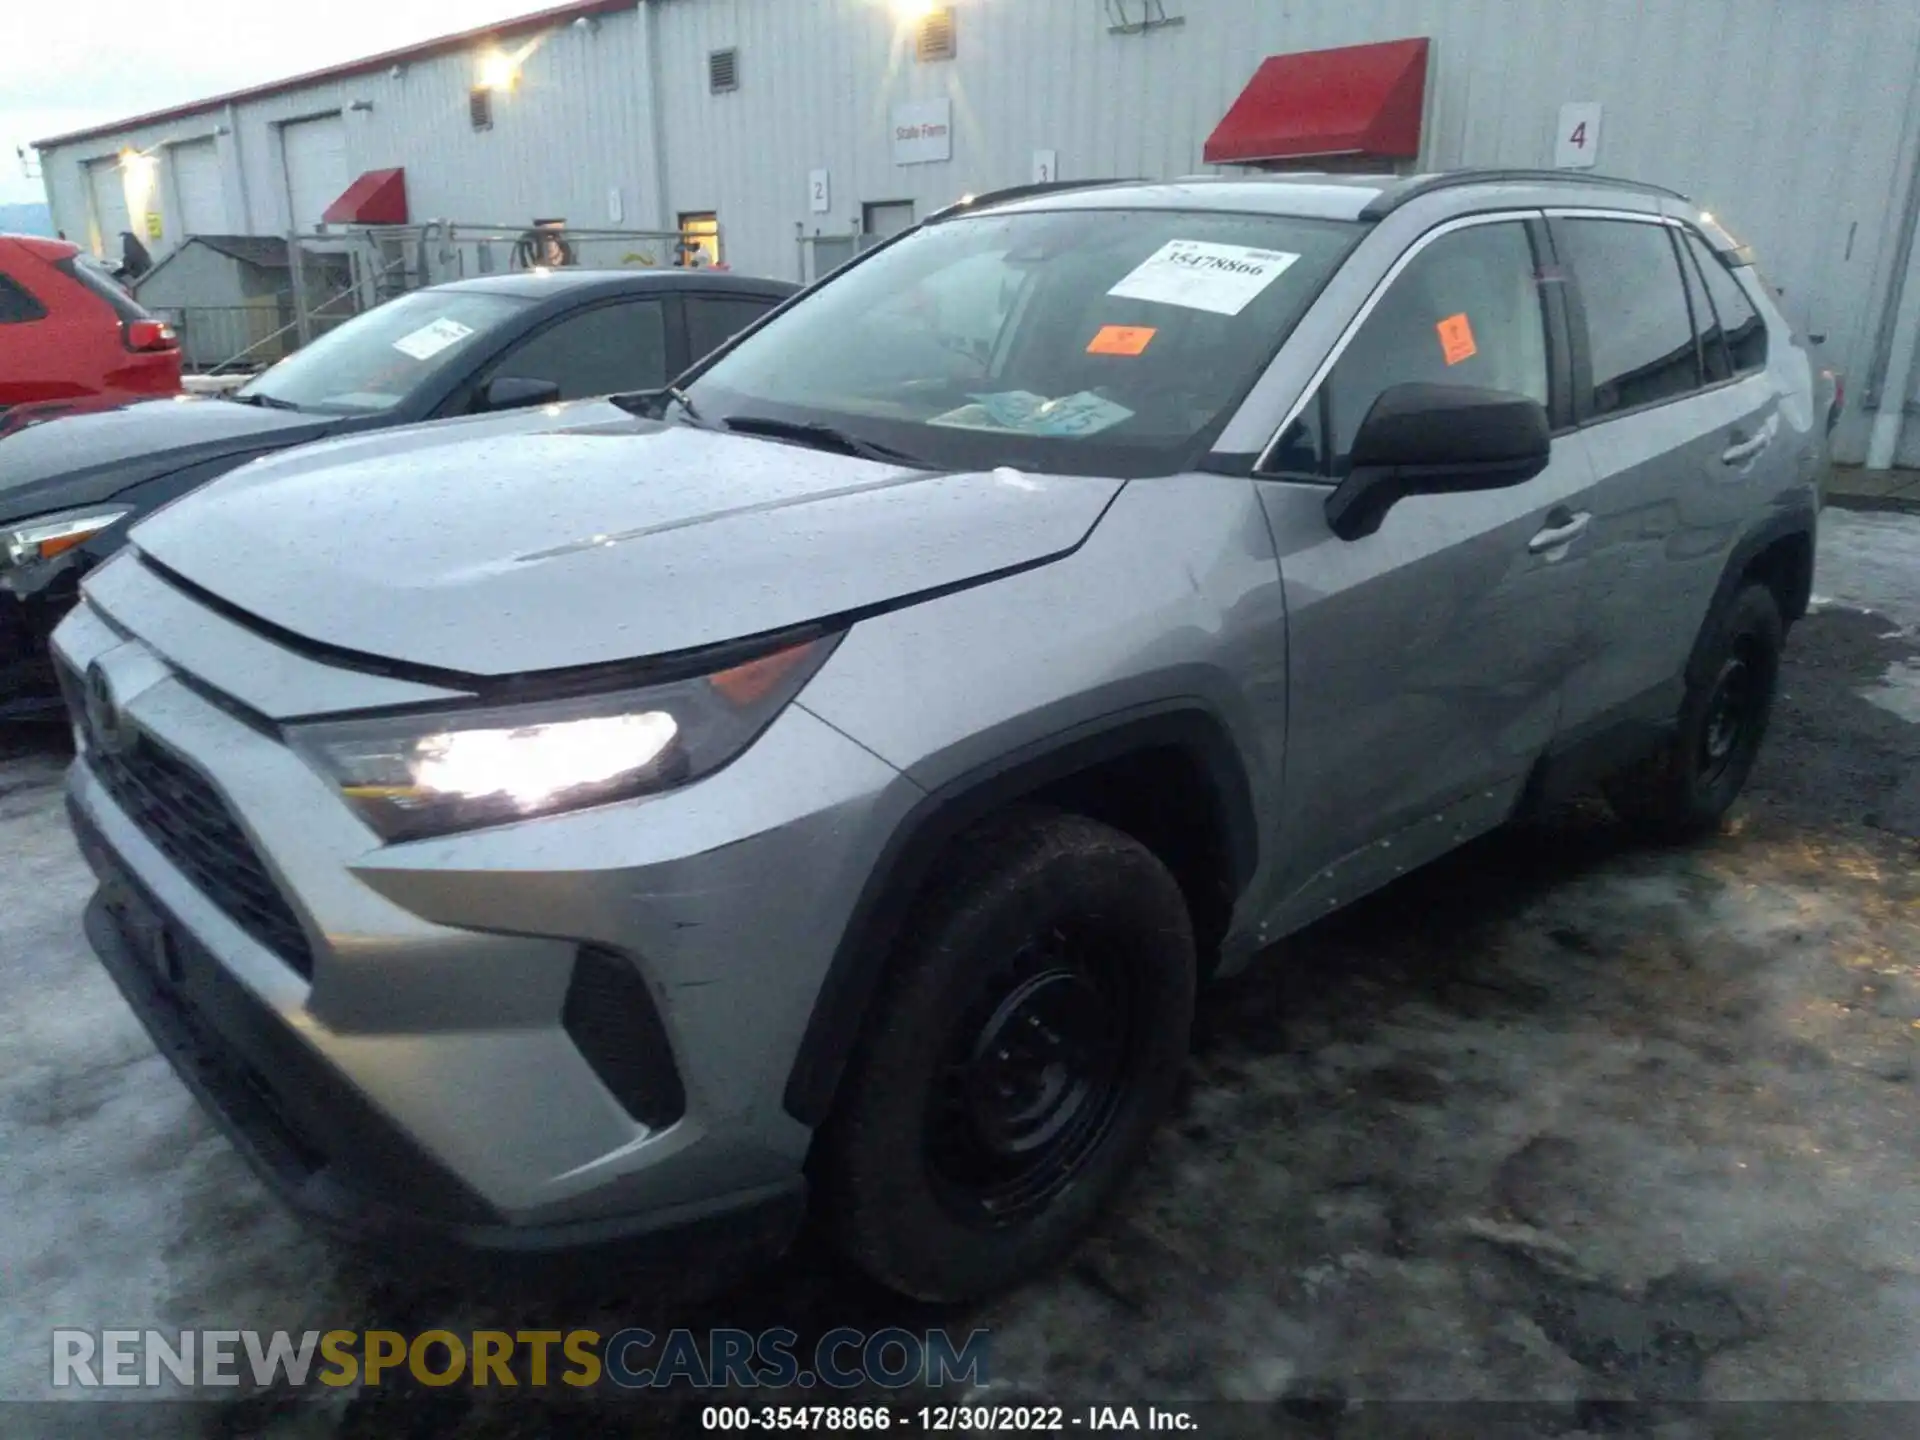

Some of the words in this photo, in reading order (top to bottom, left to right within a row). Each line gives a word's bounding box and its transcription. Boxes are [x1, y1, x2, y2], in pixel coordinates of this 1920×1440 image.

[1570, 121, 1586, 149] 4
[1039, 164, 1048, 184] 3
[814, 181, 824, 200] 2
